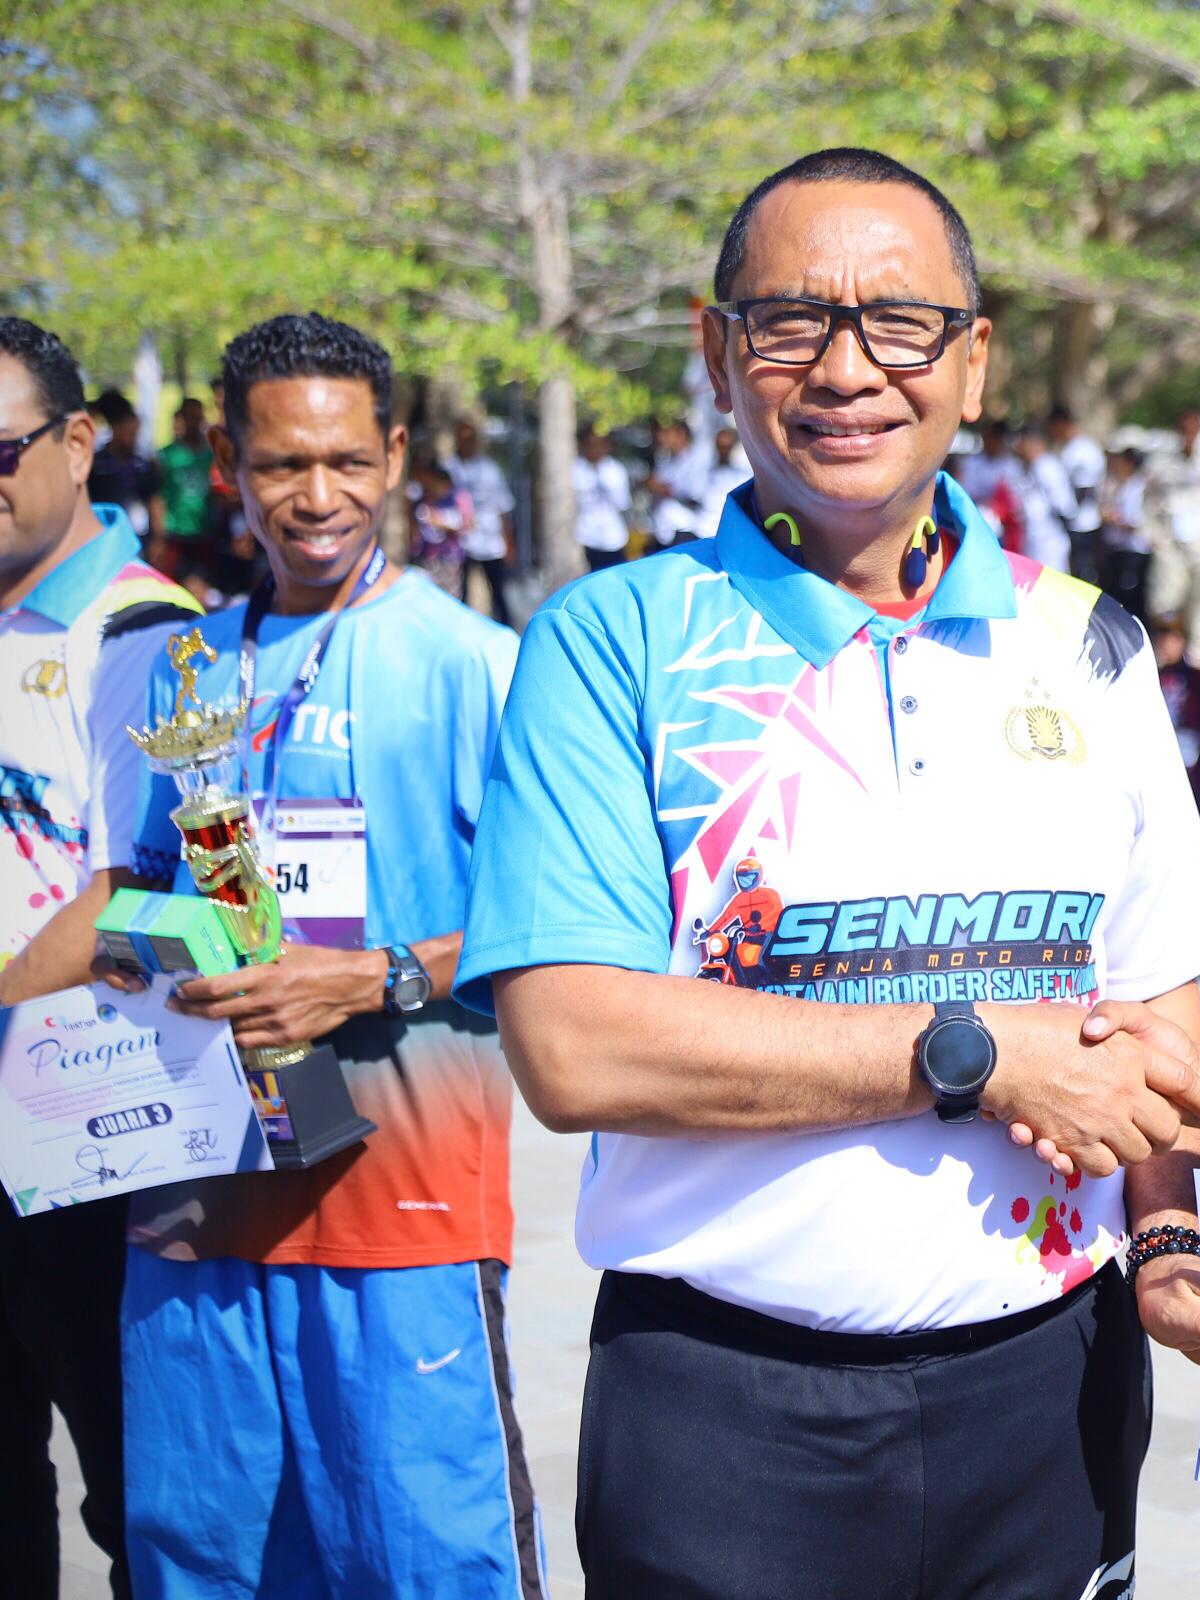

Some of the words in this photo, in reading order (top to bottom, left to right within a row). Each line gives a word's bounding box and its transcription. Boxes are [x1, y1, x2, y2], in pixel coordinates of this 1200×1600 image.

[769, 891, 1105, 957] SENMORI
[789, 957, 893, 978] SENJA
[928, 950, 1012, 967] MOTO
[1042, 949, 1090, 963] RIDE
[874, 969, 988, 1003] BORDER
[990, 967, 1079, 1001] SAFETY
[27, 1031, 163, 1078] Piagam
[95, 1108, 150, 1137] JUARA
[152, 1104, 168, 1124] 3
